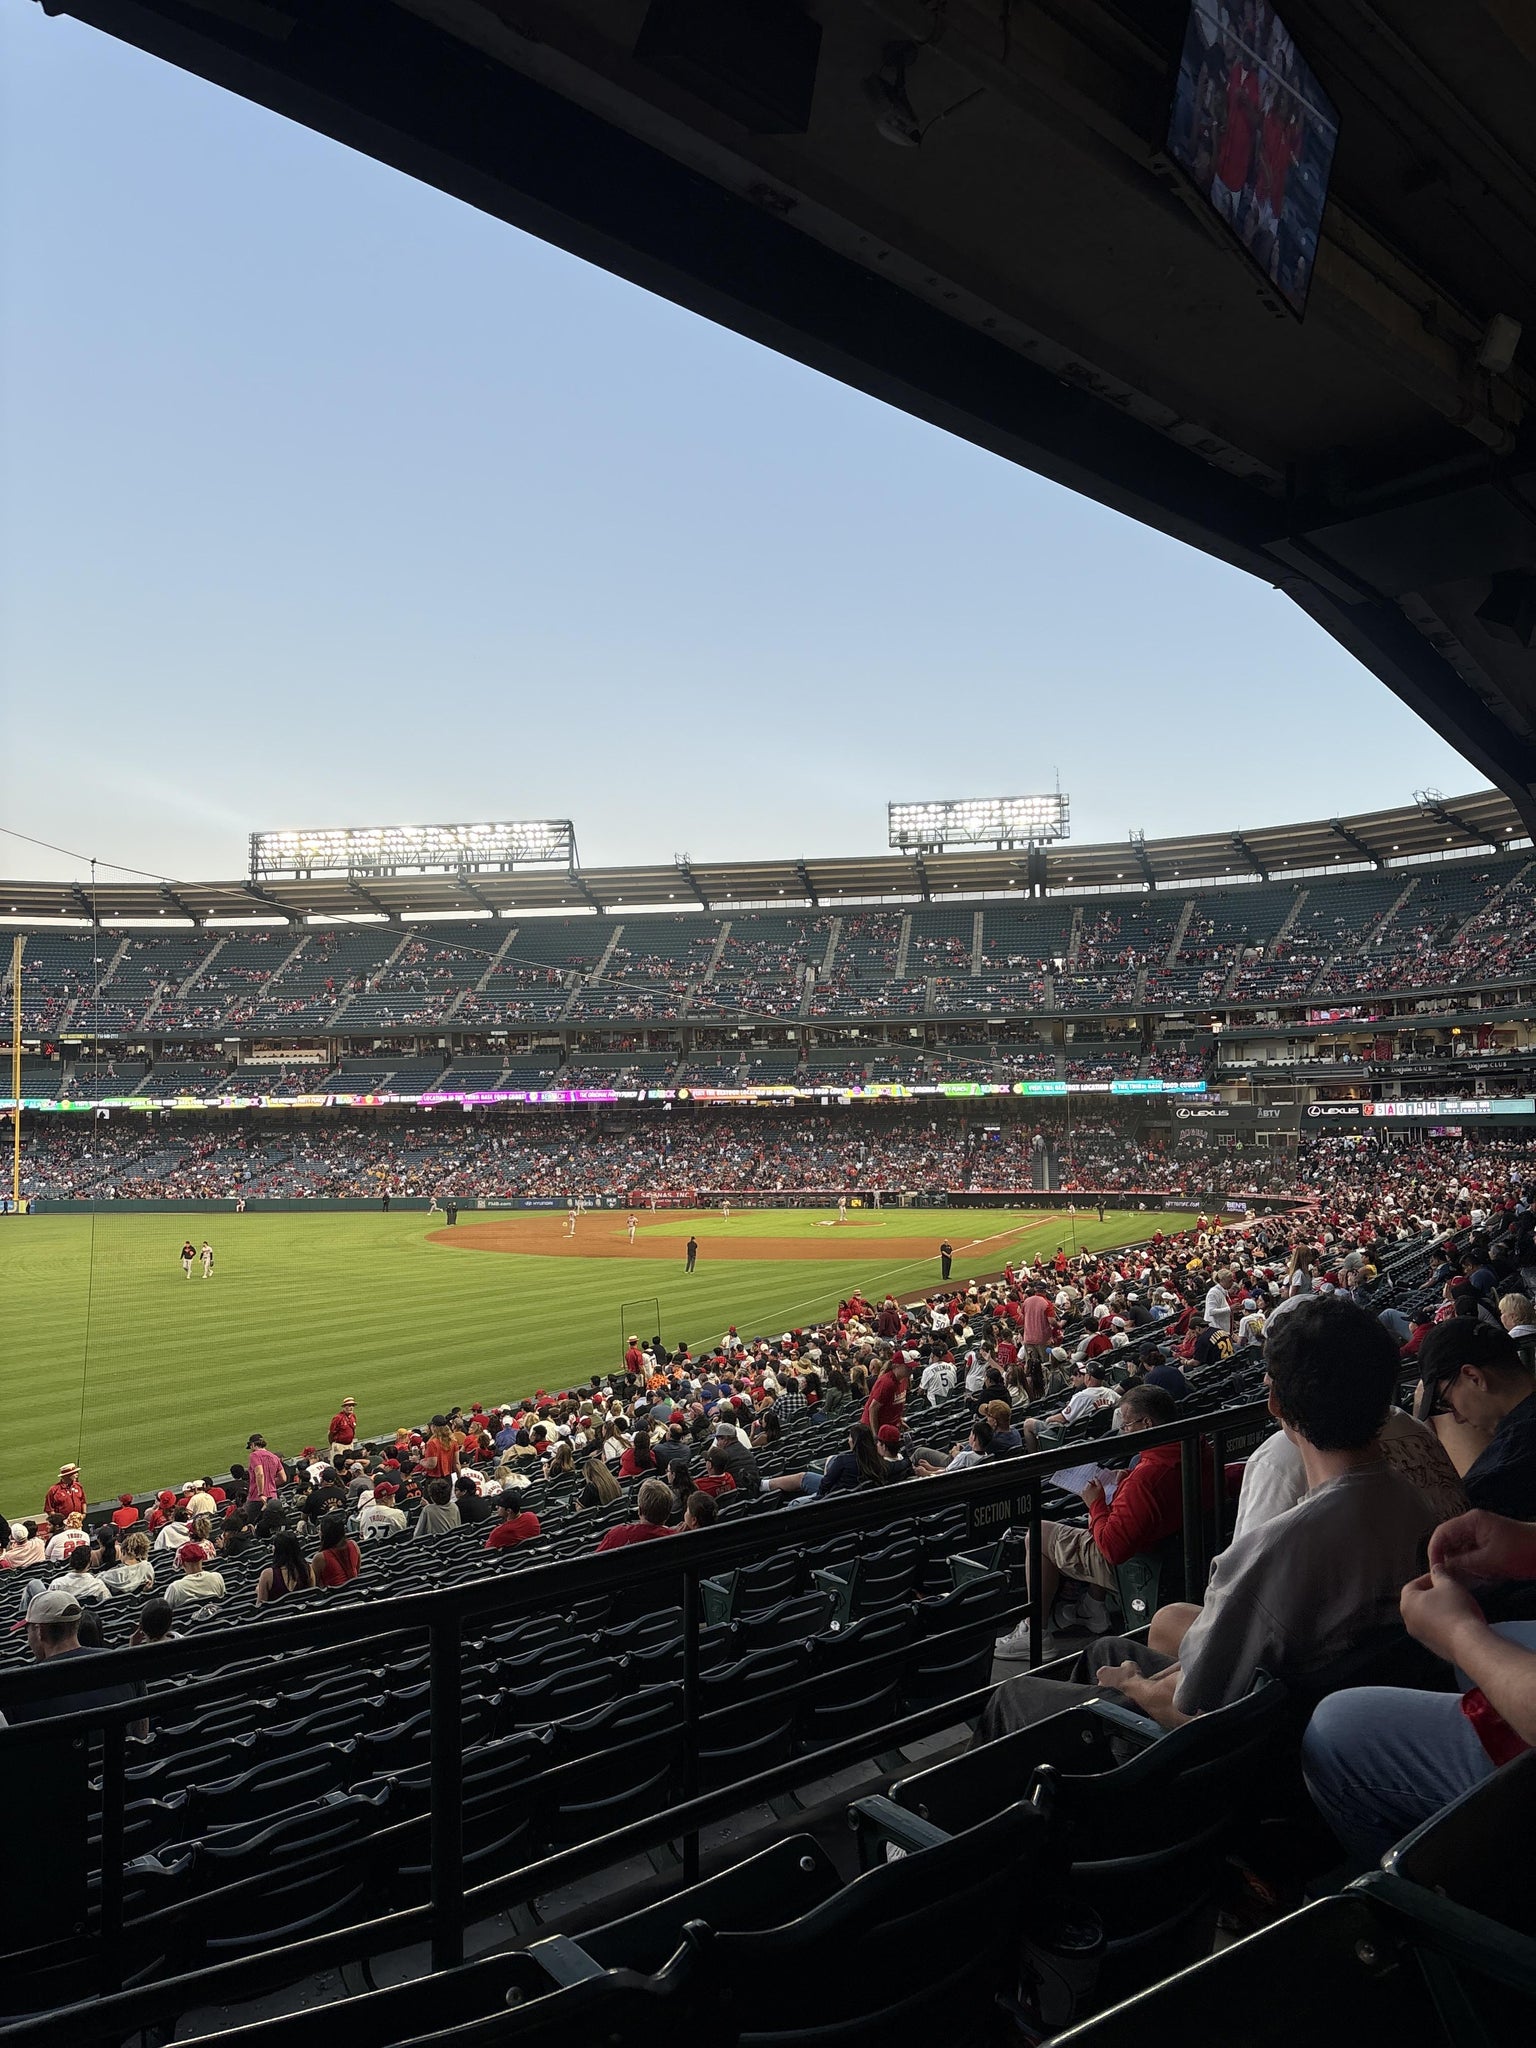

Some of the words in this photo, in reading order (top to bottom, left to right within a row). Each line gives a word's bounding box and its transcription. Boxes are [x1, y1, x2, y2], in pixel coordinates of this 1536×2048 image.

[1217, 1338, 1234, 1360] 24
[940, 1372, 949, 1387] 5
[974, 1499, 1011, 1527] SECTION
[1017, 1494, 1031, 1515] 103
[367, 1525, 390, 1539] 27
